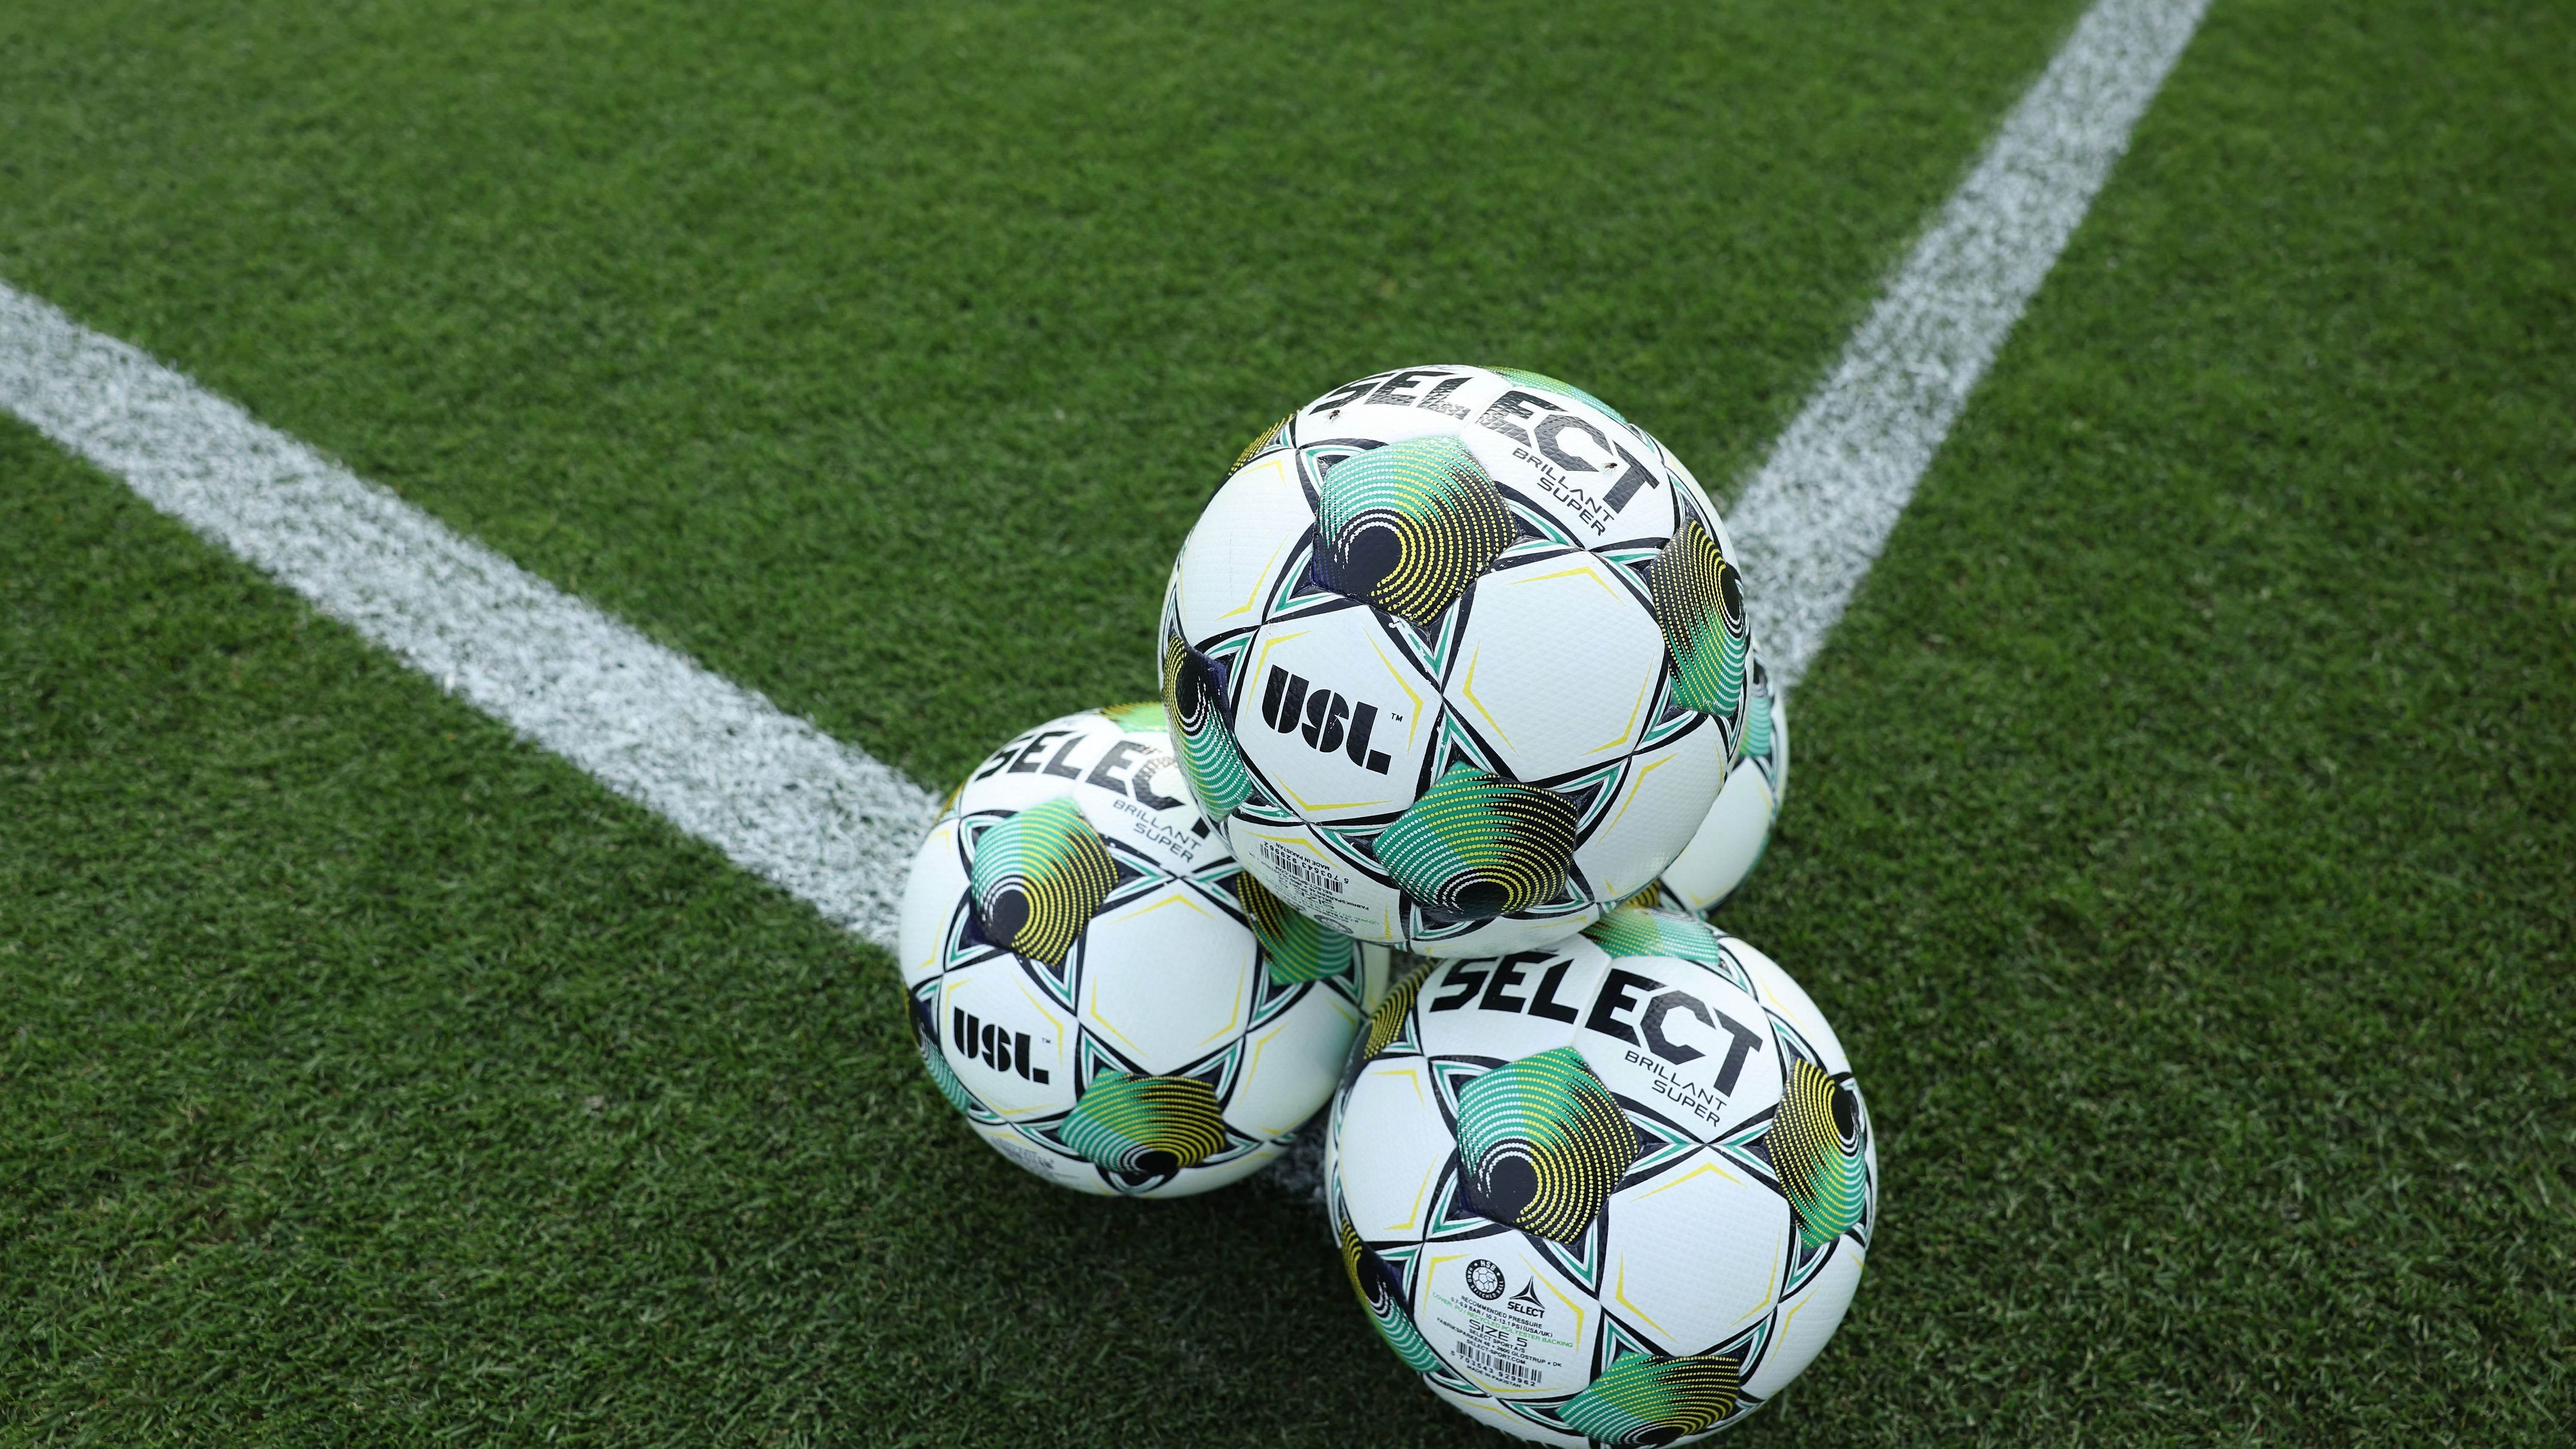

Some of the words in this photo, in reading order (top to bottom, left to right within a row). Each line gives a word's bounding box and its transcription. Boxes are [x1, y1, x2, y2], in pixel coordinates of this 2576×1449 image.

[1309, 370, 1660, 515] SELECT
[1512, 447, 1615, 522] BRILLANT
[1537, 477, 1606, 537] SUPER
[1262, 664, 1391, 775] USL
[975, 731, 1211, 840] SELEC
[1113, 799, 1202, 849] BRILLANT
[1134, 823, 1195, 863] SUPER
[1264, 841, 1297, 863] 929962
[1276, 843, 1303, 860] PAKISTAN
[1301, 862, 1338, 881] 703543
[1312, 860, 1330, 871] MADE
[1429, 952, 1763, 1097] SELECT
[954, 1006, 1049, 1085] USL
[1625, 1050, 1727, 1111] BRILLANT
[1651, 1079, 1720, 1128] SUPER
[1481, 1260, 1496, 1271] HSB
[1461, 1295, 1507, 1318] RECOMMENDED
[1508, 1315, 1542, 1329] PRESSURE
[1469, 1306, 1481, 1315] BAR
[1507, 1301, 1544, 1318] SELECT
[1467, 1311, 1500, 1328] RECYCLED
[1502, 1325, 1540, 1340] POLYESTER
[1542, 1337, 1573, 1348] BACKING
[1469, 1319, 1509, 1341] SIZE
[1516, 1337, 1527, 1347] 5
[1469, 1329, 1491, 1341] SELECT
[1493, 1338, 1513, 1349] SPORT
[1511, 1351, 1545, 1364] GLOSTRUP
[1467, 1365, 1483, 1374] MADE
[1492, 1375, 1521, 1388] PAKISTAN
